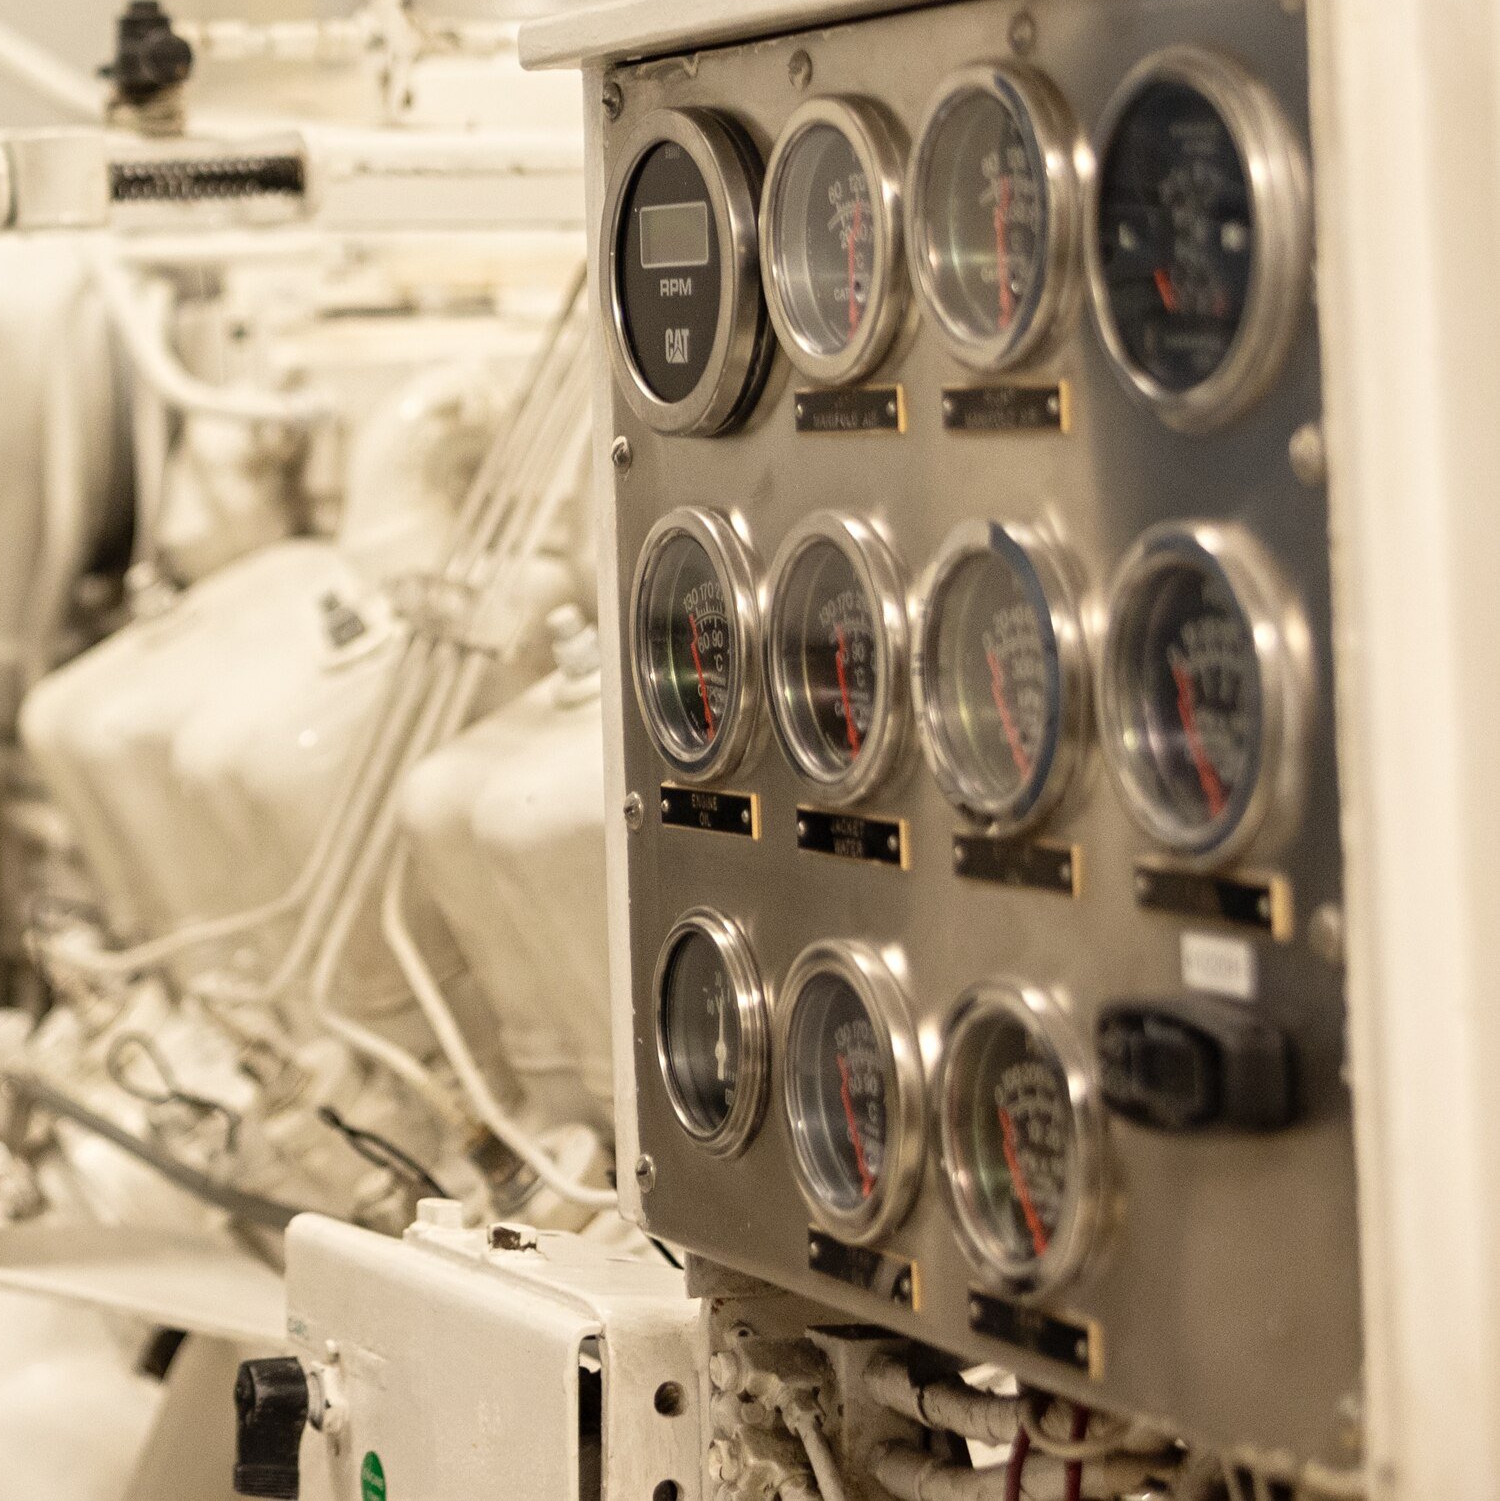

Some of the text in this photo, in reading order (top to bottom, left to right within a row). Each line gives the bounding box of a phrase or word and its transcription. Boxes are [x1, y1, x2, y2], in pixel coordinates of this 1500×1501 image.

[659, 277, 693, 297] RPM
[664, 327, 690, 364] CAT
[691, 793, 718, 812] ENGINE
[699, 811, 712, 828] OIL
